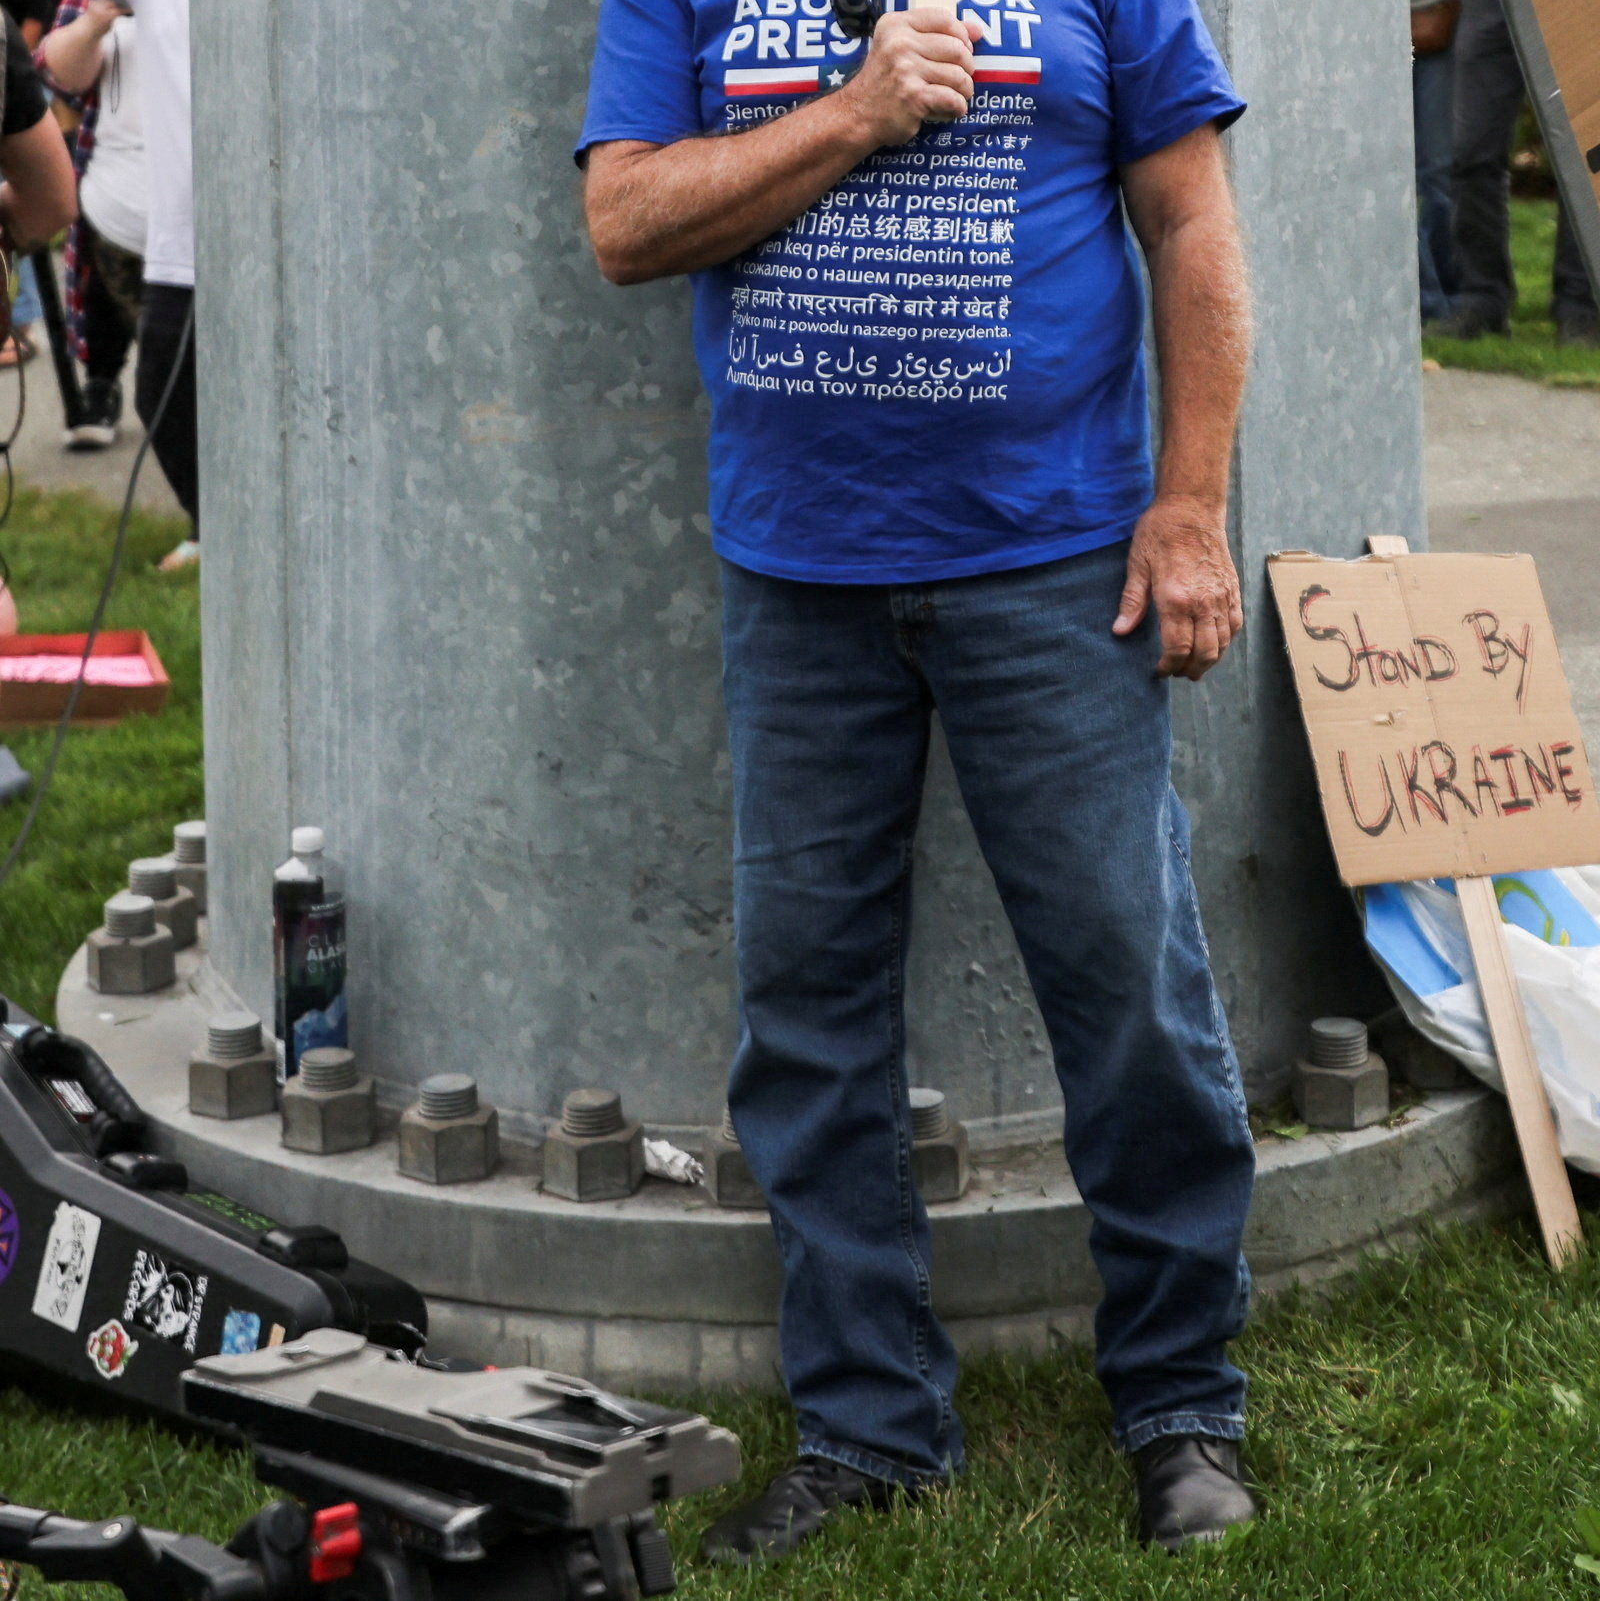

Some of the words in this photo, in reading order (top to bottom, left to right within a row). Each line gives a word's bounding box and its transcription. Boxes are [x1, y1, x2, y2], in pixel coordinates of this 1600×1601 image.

[725, 102, 788, 121] Siento
[970, 89, 1037, 111] idente.
[871, 152, 926, 166] nostro
[929, 151, 1027, 171] presidente.
[881, 170, 930, 186] notre
[934, 171, 1019, 191] président.
[863, 188, 899, 209] vår
[905, 192, 1021, 214] president.
[787, 210, 1016, 245] 们的总统感到抱歉
[784, 237, 813, 261] keq
[816, 241, 849, 261] për
[852, 245, 964, 265] presidentin
[969, 248, 1015, 266] tonë.
[743, 261, 803, 280] сожалею
[822, 266, 890, 287] нашем
[894, 270, 1013, 291] президенте
[752, 286, 786, 309] हमारे
[903, 295, 938, 318] बारे
[763, 316, 777, 329] mi
[779, 319, 787, 330] z
[788, 320, 850, 335] powodu
[853, 323, 919, 341] naszego
[921, 323, 1013, 342] prezydenta.
[726, 365, 781, 392] Λυπάμαι
[784, 377, 815, 396] για
[820, 379, 858, 396] τον
[968, 383, 1009, 403] μας
[1337, 739, 1584, 837] UKRAINE
[306, 942, 347, 961] ALAS
[121, 1249, 148, 1322] RECORDS
